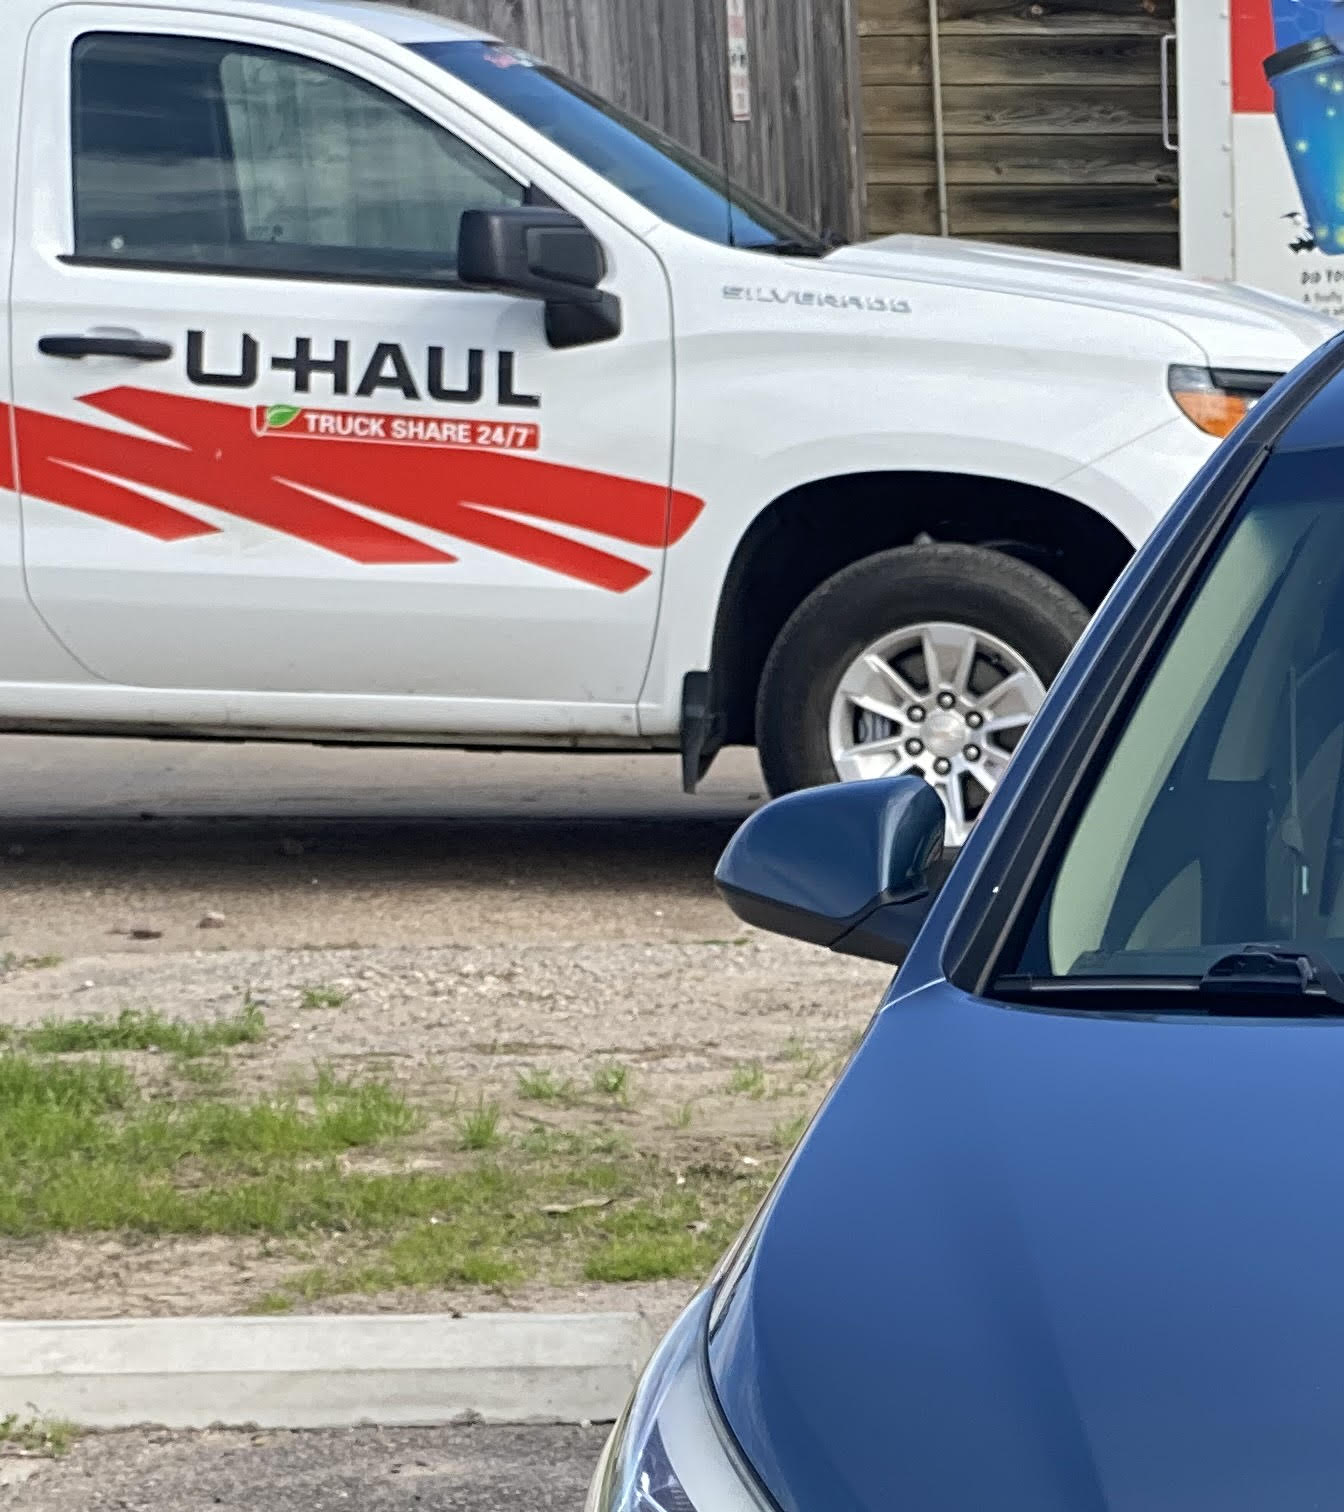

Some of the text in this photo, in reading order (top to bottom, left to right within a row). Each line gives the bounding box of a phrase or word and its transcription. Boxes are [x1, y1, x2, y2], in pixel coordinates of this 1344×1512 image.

[186, 329, 541, 408] U-HAUL
[303, 412, 529, 449] TRUCK SHARE 24/7
